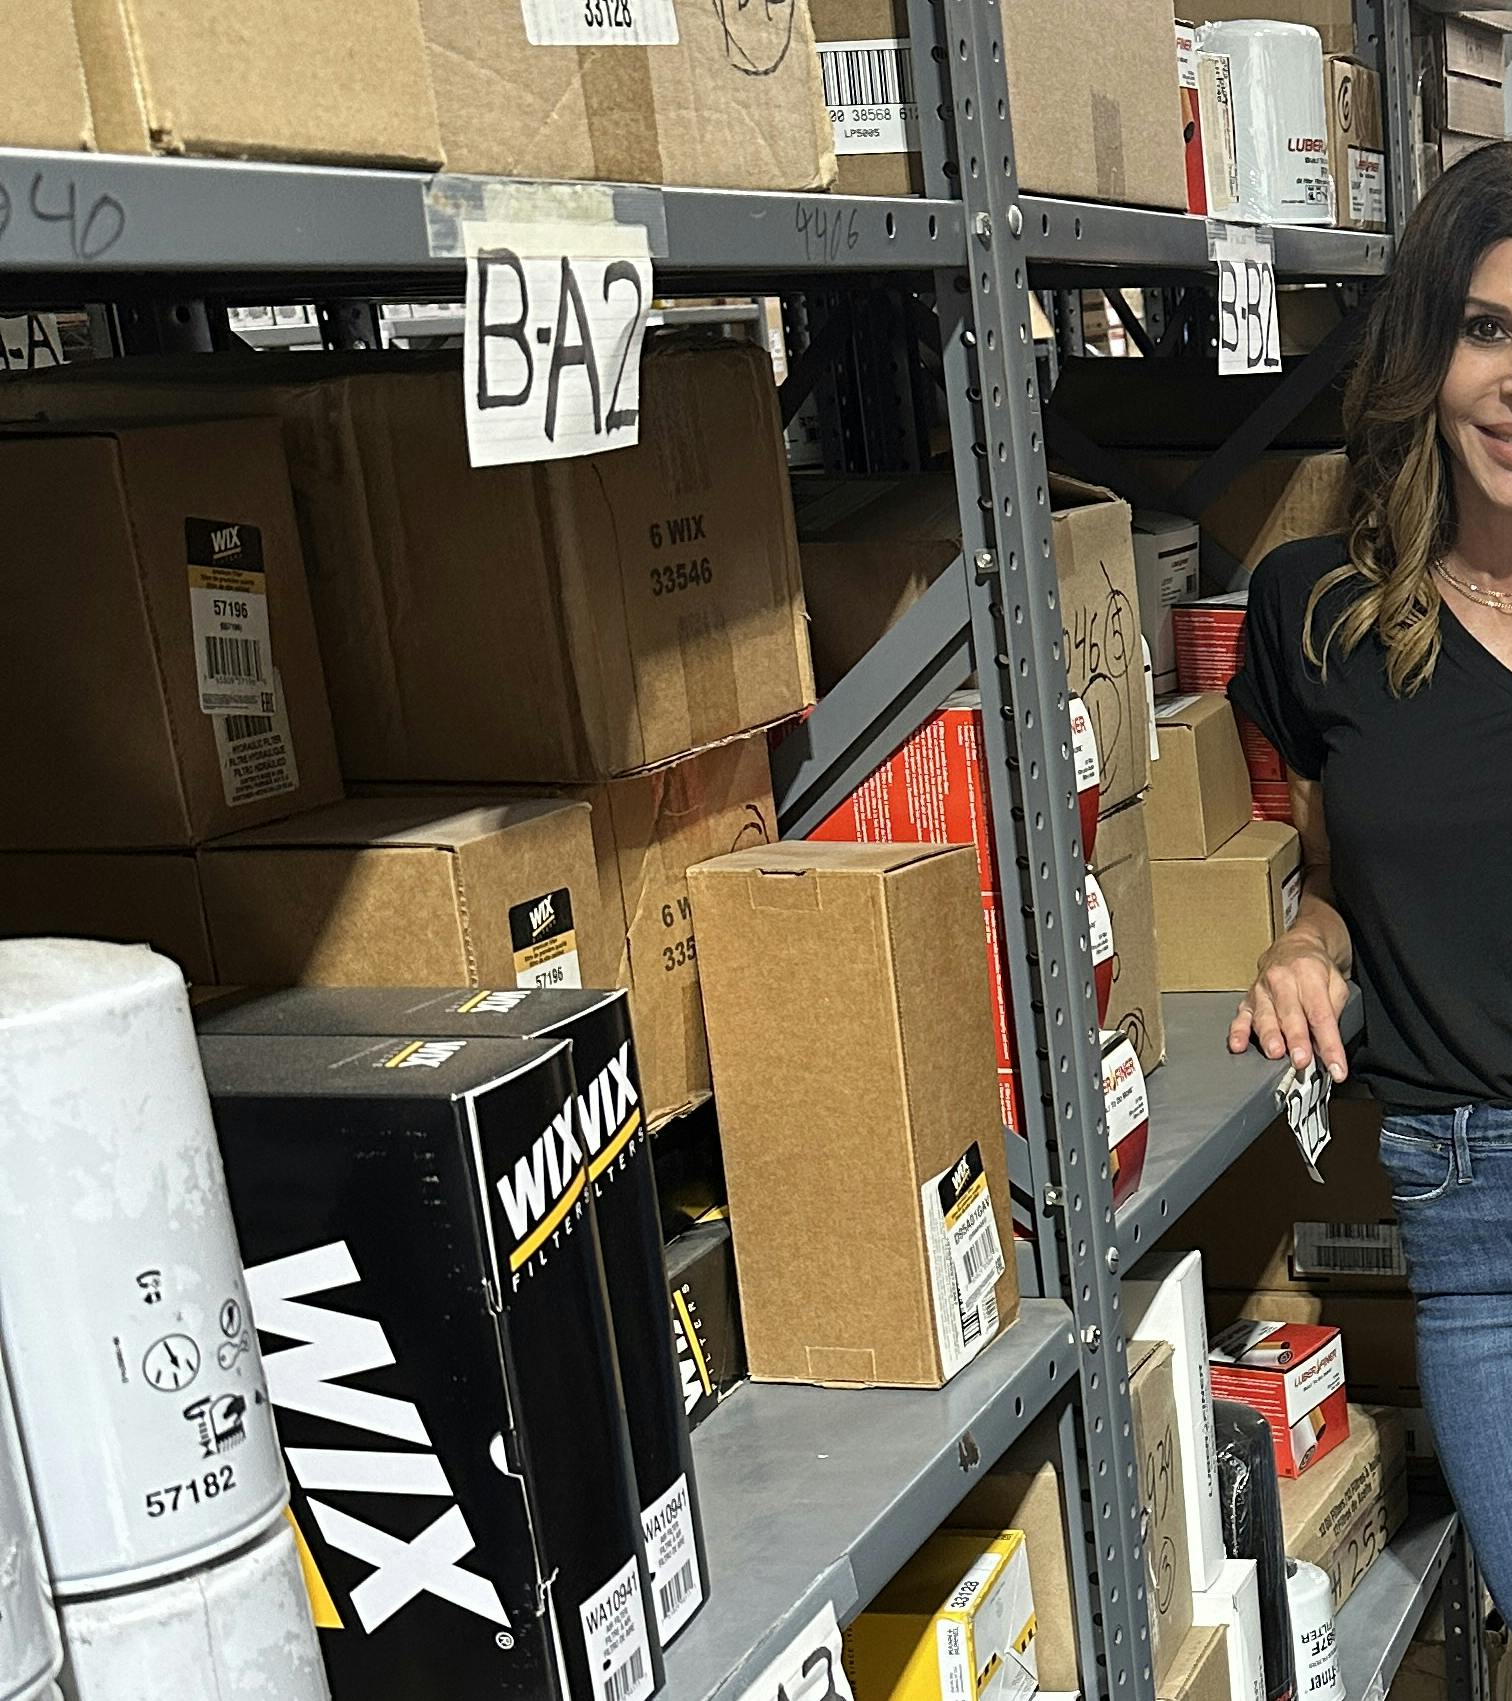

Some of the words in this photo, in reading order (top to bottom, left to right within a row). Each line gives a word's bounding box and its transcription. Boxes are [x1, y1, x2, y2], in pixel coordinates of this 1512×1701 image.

[852, 109, 891, 121] 38568
[0, 172, 124, 259] 40
[211, 526, 241, 553] WIX
[650, 523, 663, 550] 6
[666, 515, 706, 546] WIX
[650, 557, 713, 597] 33546
[213, 599, 249, 619] 57196
[529, 894, 555, 930] WIX
[661, 903, 675, 928] 6
[662, 934, 697, 972] 335
[497, 1091, 583, 1241] WIX
[595, 1125, 645, 1198] LTERS
[951, 1154, 970, 1190] WIX
[512, 1186, 592, 1294] FILTERS
[241, 1239, 512, 1635] WIX
[144, 1463, 239, 1520] 57182
[644, 1487, 688, 1545] WA10941
[585, 1570, 638, 1636] WA10941
[950, 1580, 980, 1608] 33128
